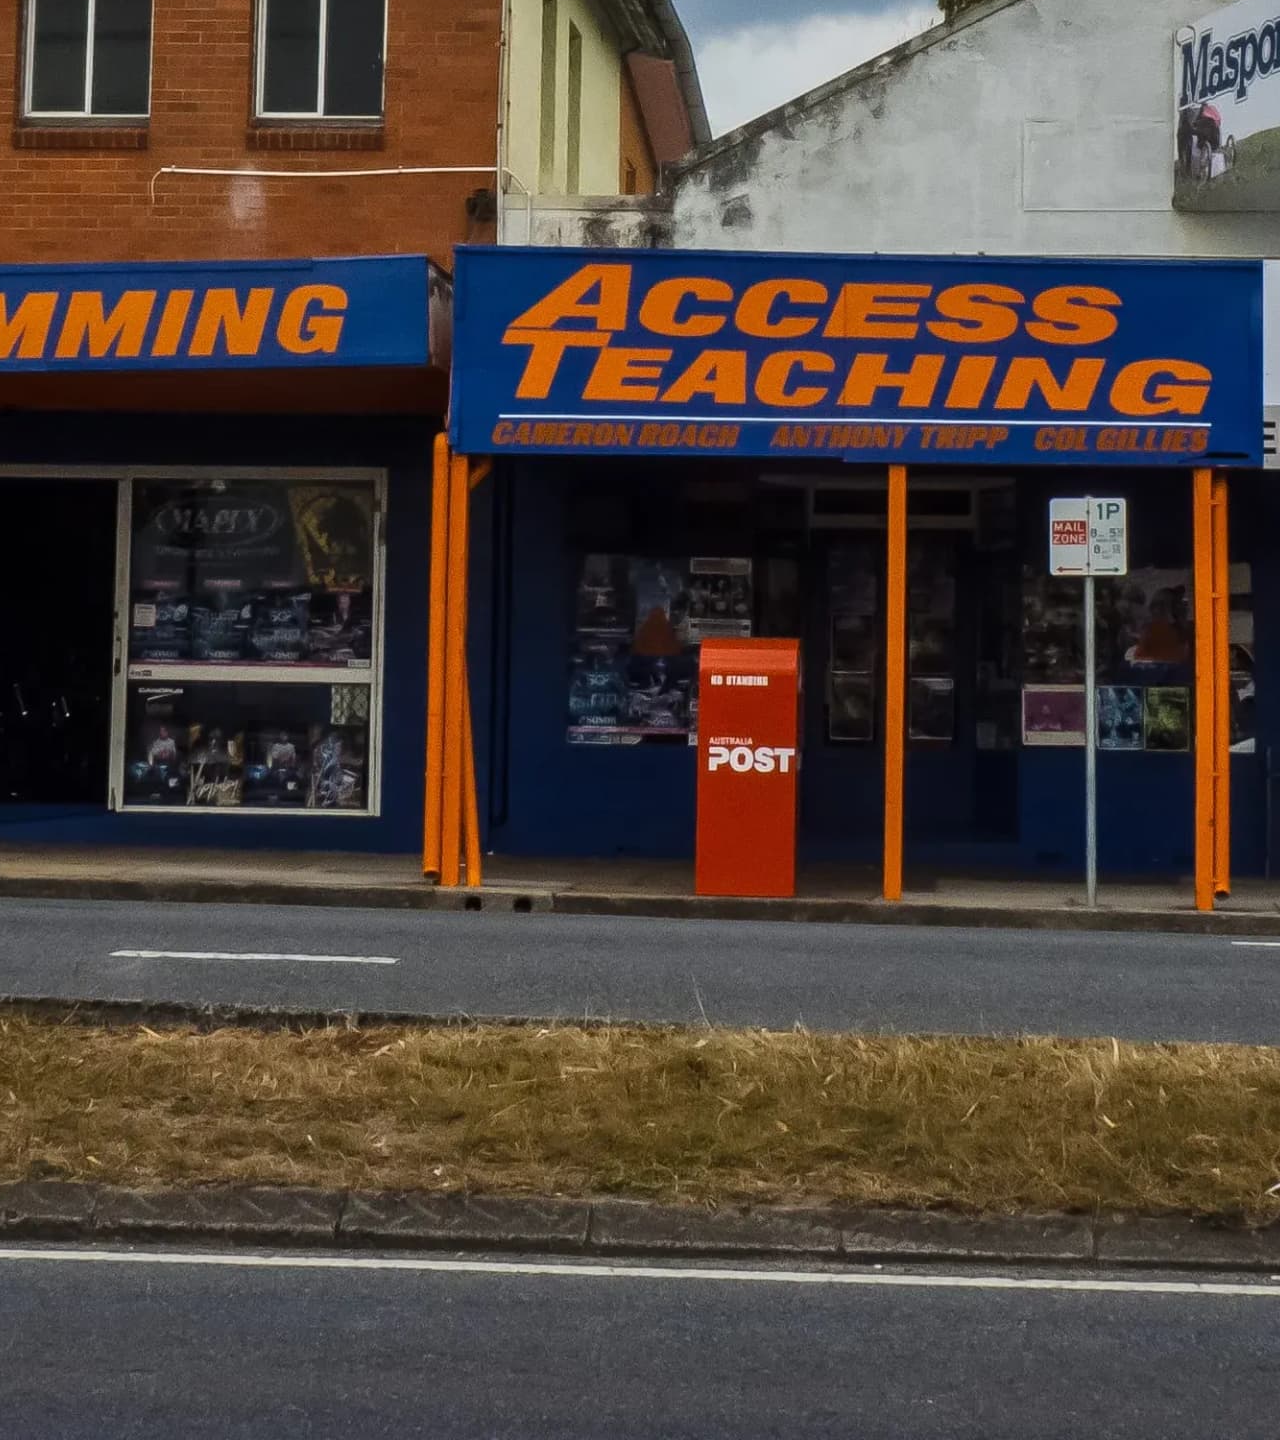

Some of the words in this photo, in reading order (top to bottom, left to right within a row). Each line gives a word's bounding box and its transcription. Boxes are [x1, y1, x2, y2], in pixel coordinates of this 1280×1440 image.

[508, 263, 1122, 345] ACCESS
[501, 328, 1213, 416] TEACHING
[491, 421, 634, 446] CAMERON
[637, 423, 740, 448] ROACH
[769, 425, 909, 449] ANTHONY
[919, 426, 1009, 449] TRIPP
[1033, 427, 1089, 451] COL
[1096, 428, 1210, 452] GILLIES
[1096, 503, 1120, 520] 1P
[1054, 522, 1085, 532] MAIL
[1053, 534, 1086, 544] ZONE
[709, 737, 753, 746] AUSTRALIA
[708, 746, 795, 773] POST
